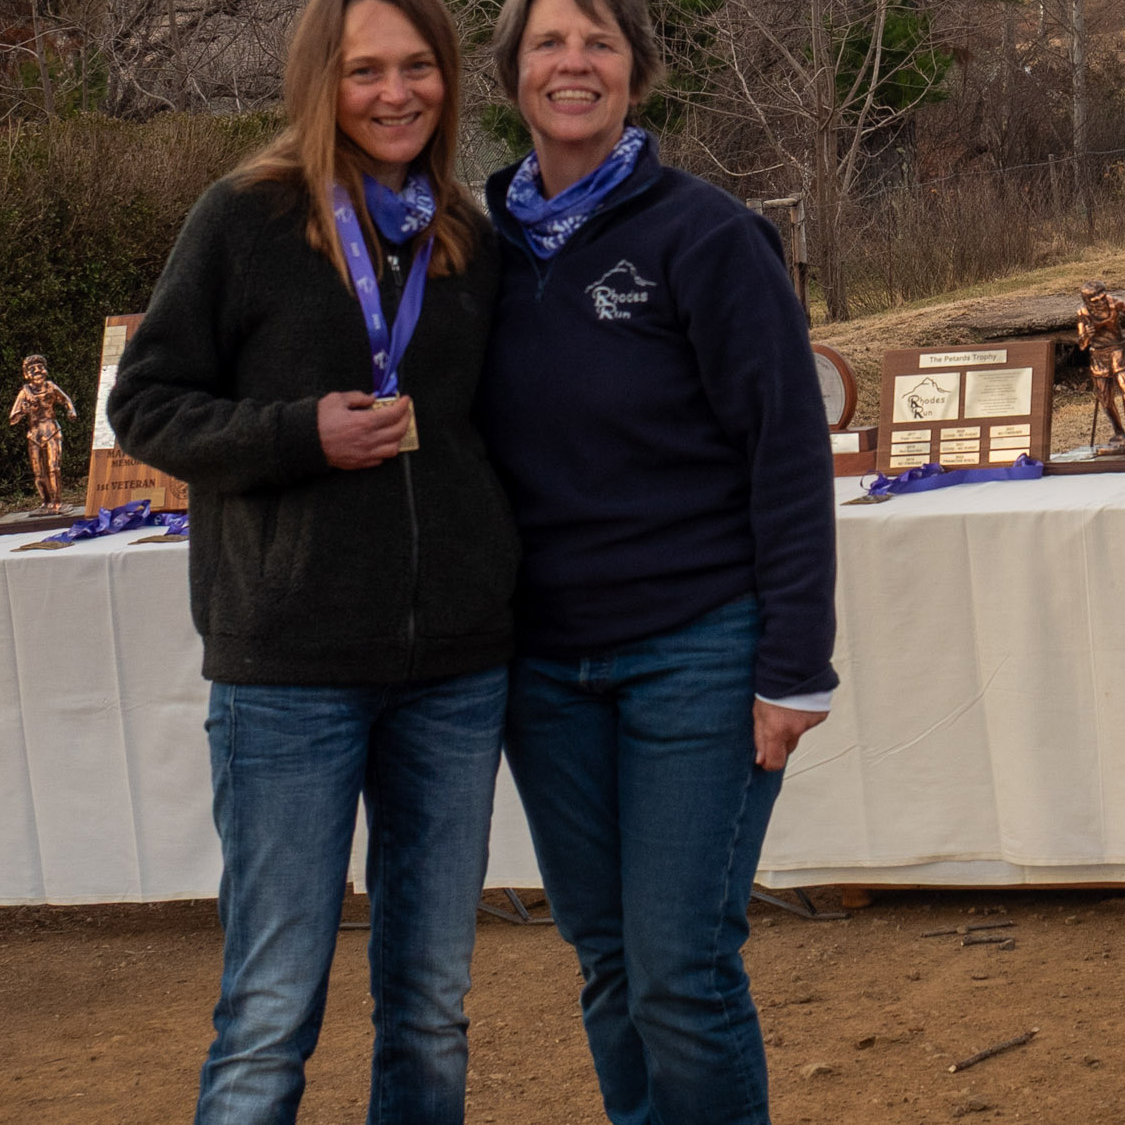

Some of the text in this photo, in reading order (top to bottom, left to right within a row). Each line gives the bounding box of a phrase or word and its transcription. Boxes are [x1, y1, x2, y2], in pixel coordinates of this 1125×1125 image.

[592, 286, 648, 306] Rhodes
[596, 302, 631, 320] Run
[929, 356, 942, 364] The
[973, 353, 997, 361] Trophy
[908, 395, 945, 408] Rhodes
[911, 405, 933, 419] Run
[111, 478, 156, 490] VETERAN
